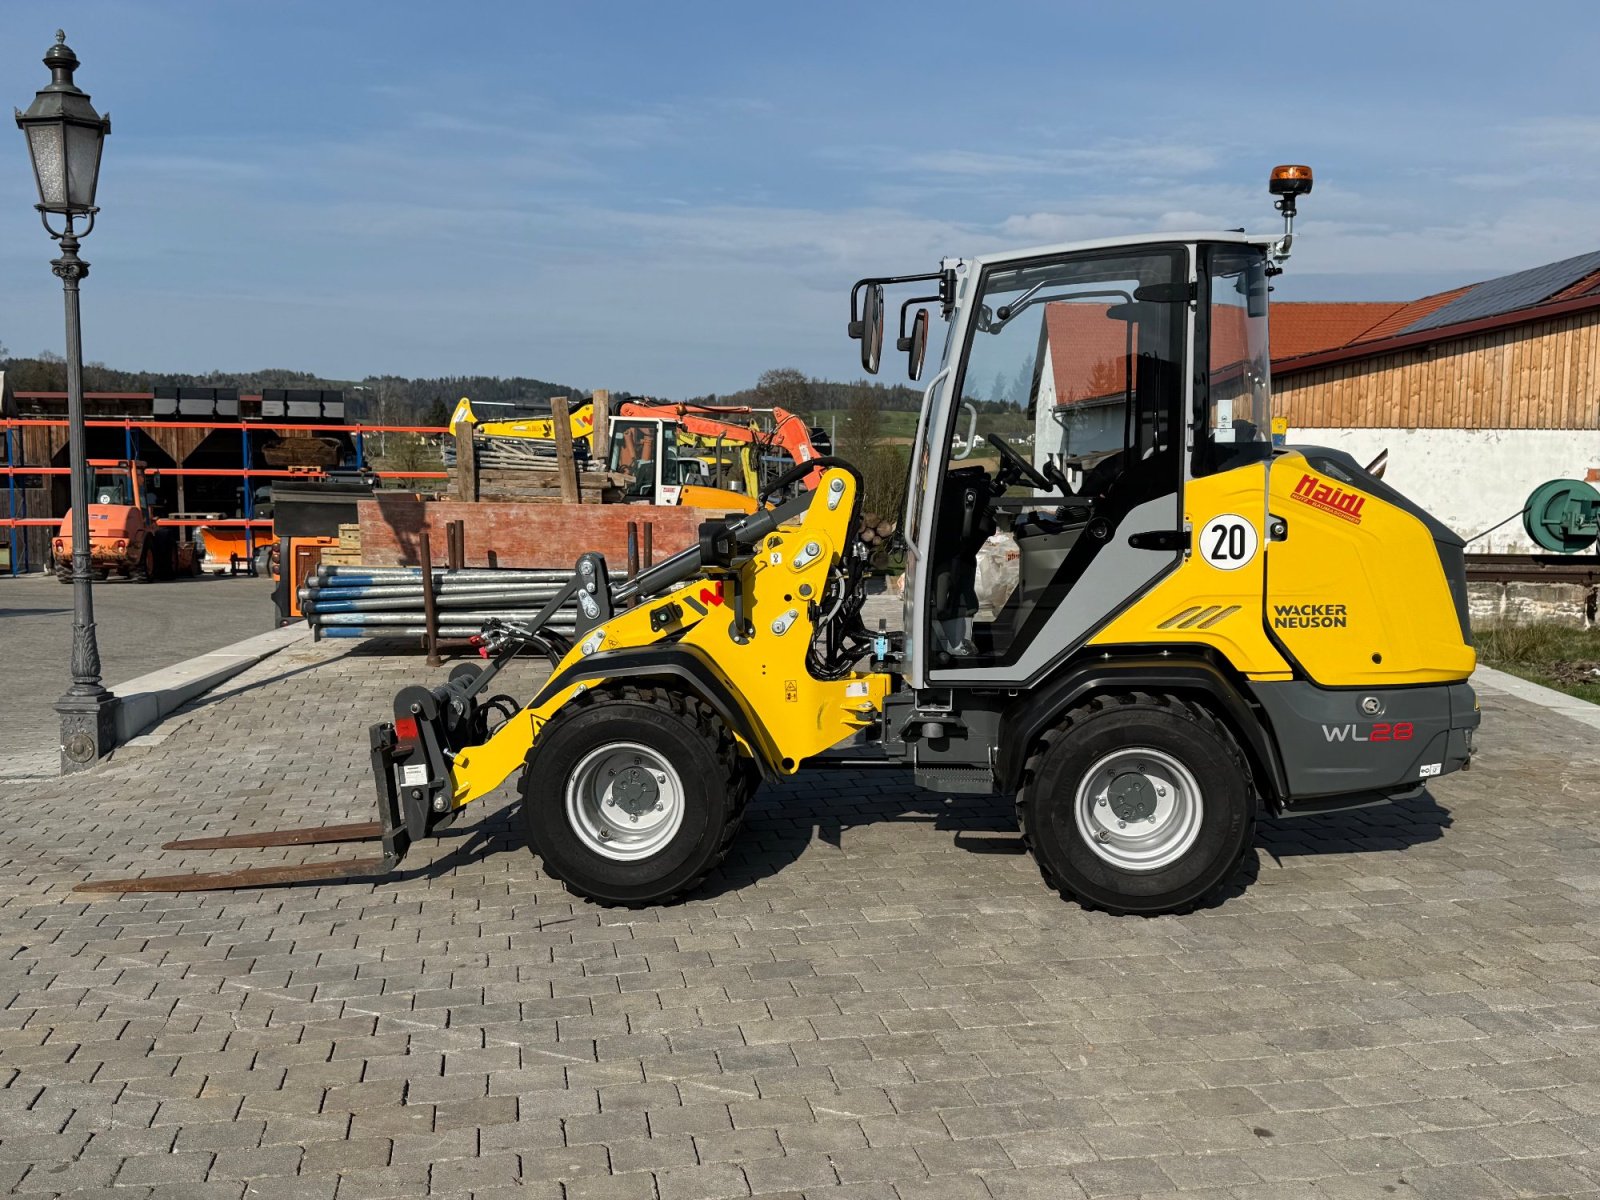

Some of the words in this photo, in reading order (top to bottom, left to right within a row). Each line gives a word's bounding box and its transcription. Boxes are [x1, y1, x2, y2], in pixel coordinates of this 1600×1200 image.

[1211, 524, 1246, 560] 20
[1274, 604, 1347, 616] WACKER
[1274, 617, 1347, 628] NEUSON
[1321, 722, 1413, 742] WL28
